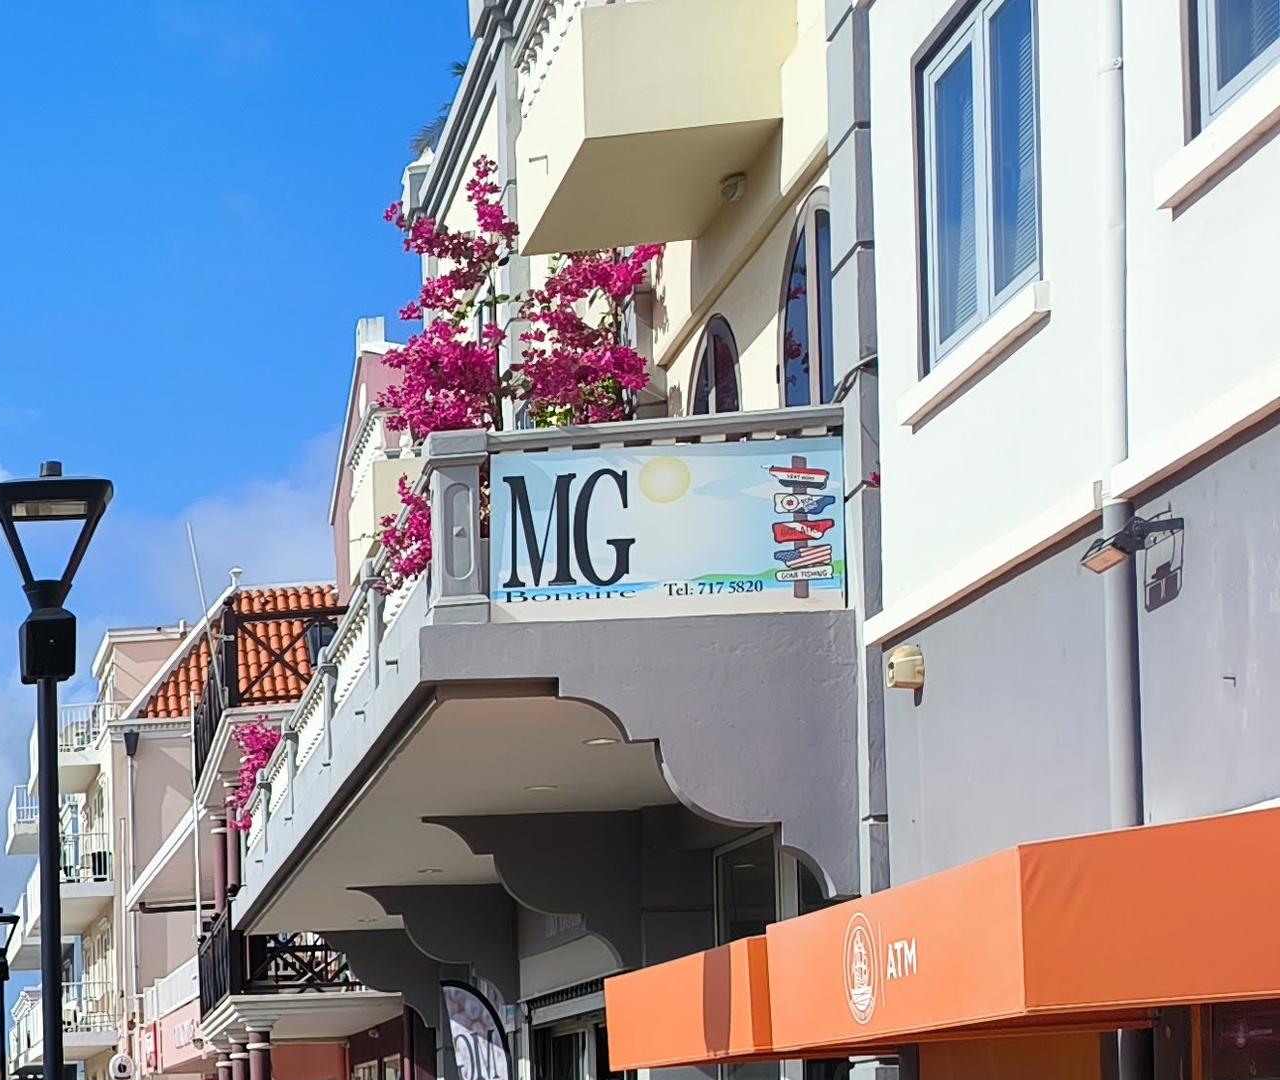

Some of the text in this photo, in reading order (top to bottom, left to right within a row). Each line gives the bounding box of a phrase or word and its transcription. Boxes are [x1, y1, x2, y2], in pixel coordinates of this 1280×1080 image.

[503, 468, 635, 588] MG
[801, 569, 828, 578] FISHING
[505, 587, 636, 603] Bonaire
[664, 580, 763, 596] Tel: 717 5820
[886, 936, 917, 981] ATM
